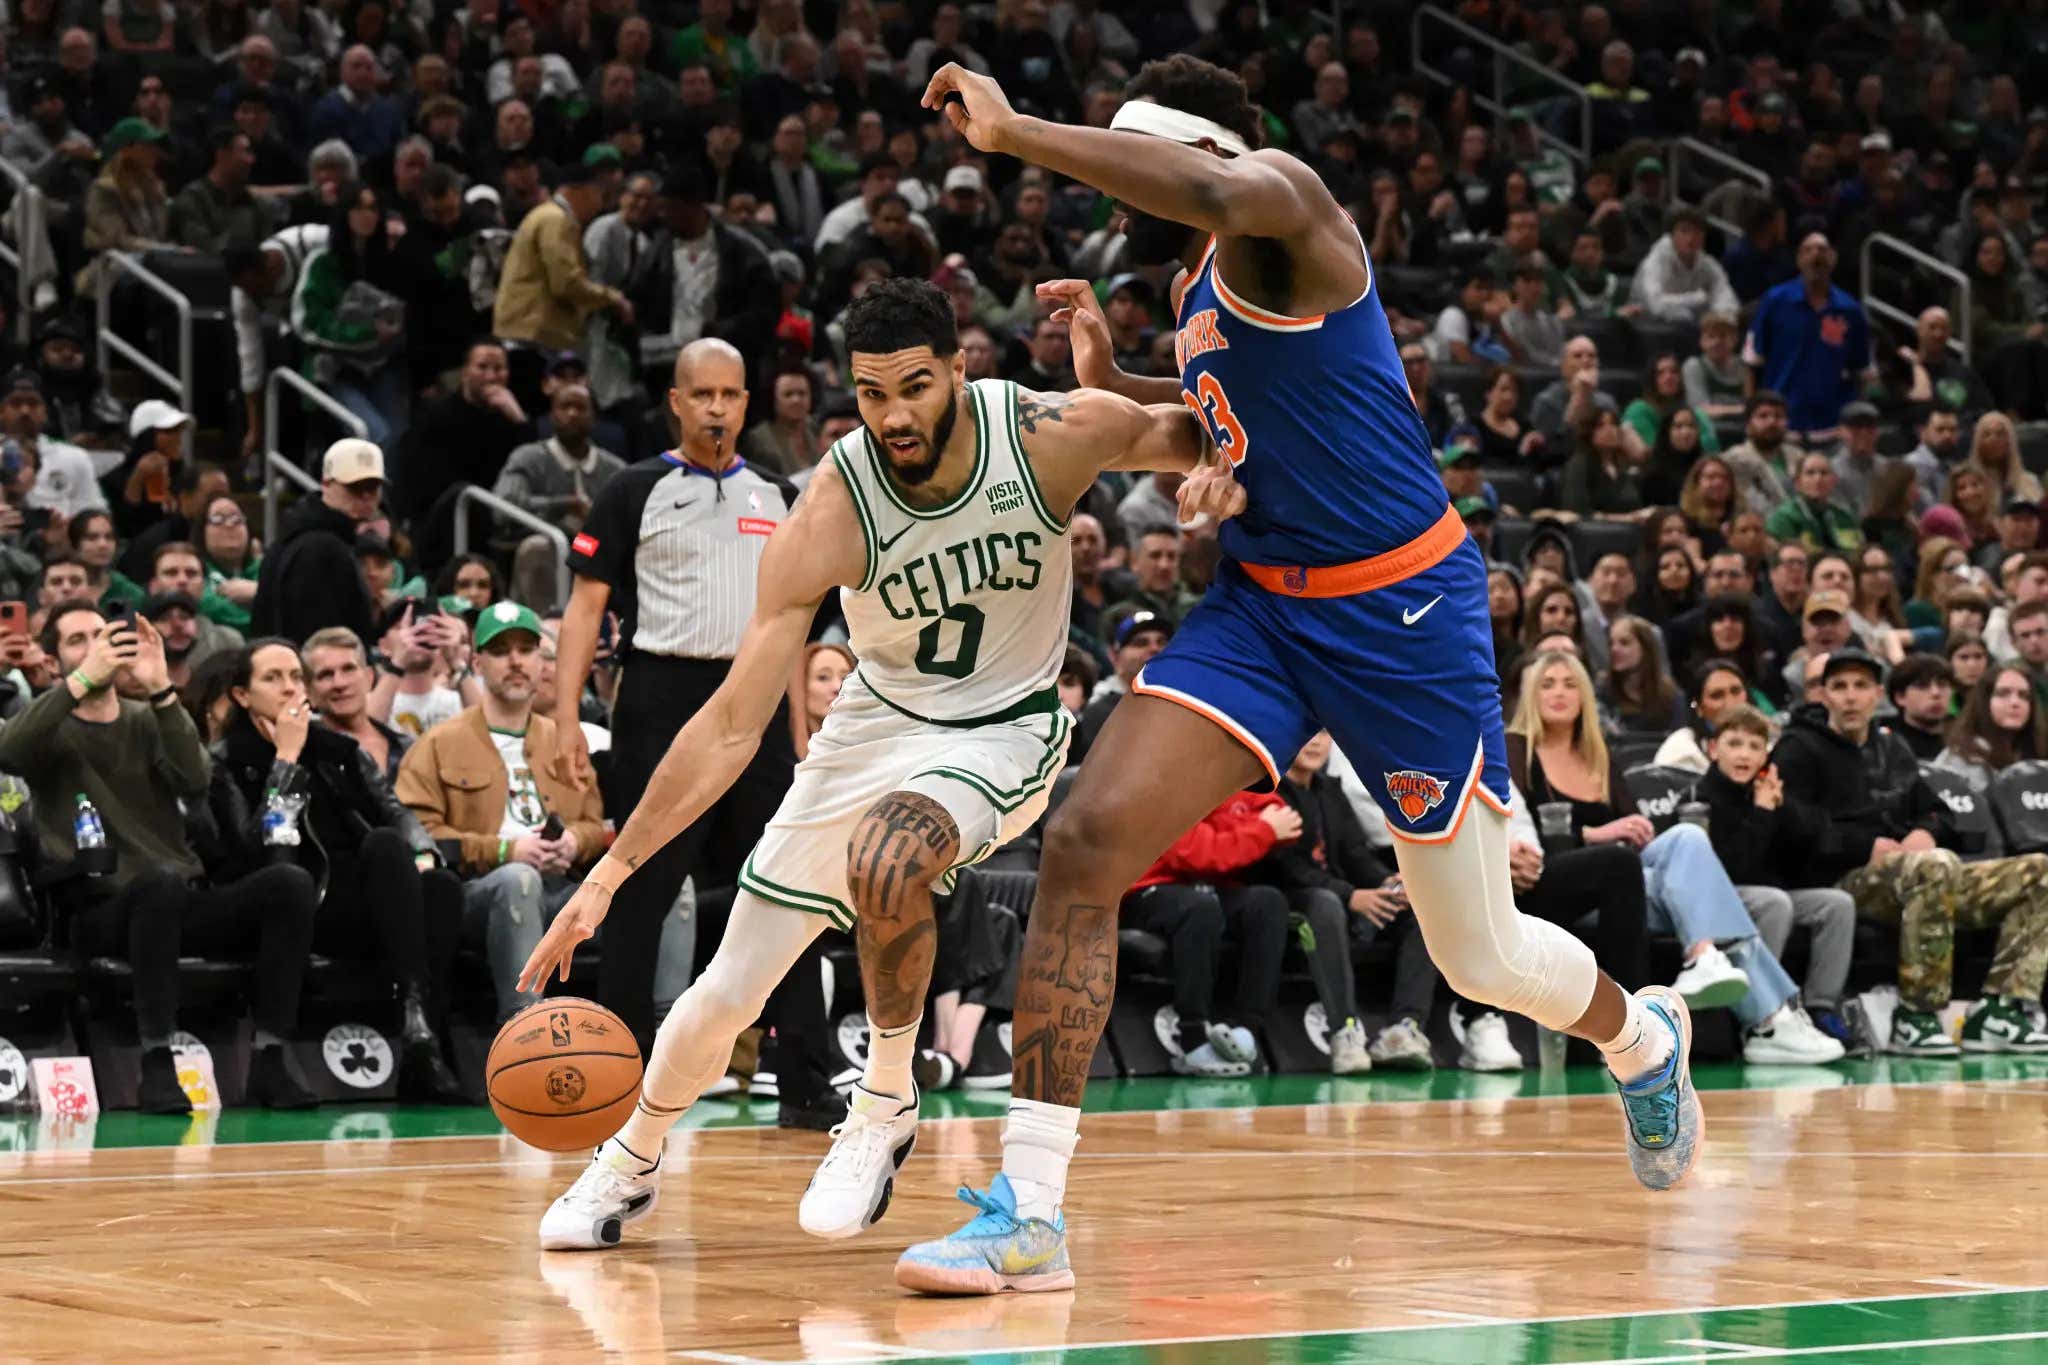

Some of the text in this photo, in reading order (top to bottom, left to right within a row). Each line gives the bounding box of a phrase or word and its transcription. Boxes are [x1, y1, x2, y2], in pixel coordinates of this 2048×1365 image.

[985, 480, 1022, 502] VISTA
[990, 495, 1025, 516] PRINT
[878, 531, 1042, 620] CELTICS
[914, 603, 986, 679] 0
[1389, 774, 1442, 801] KNICKS
